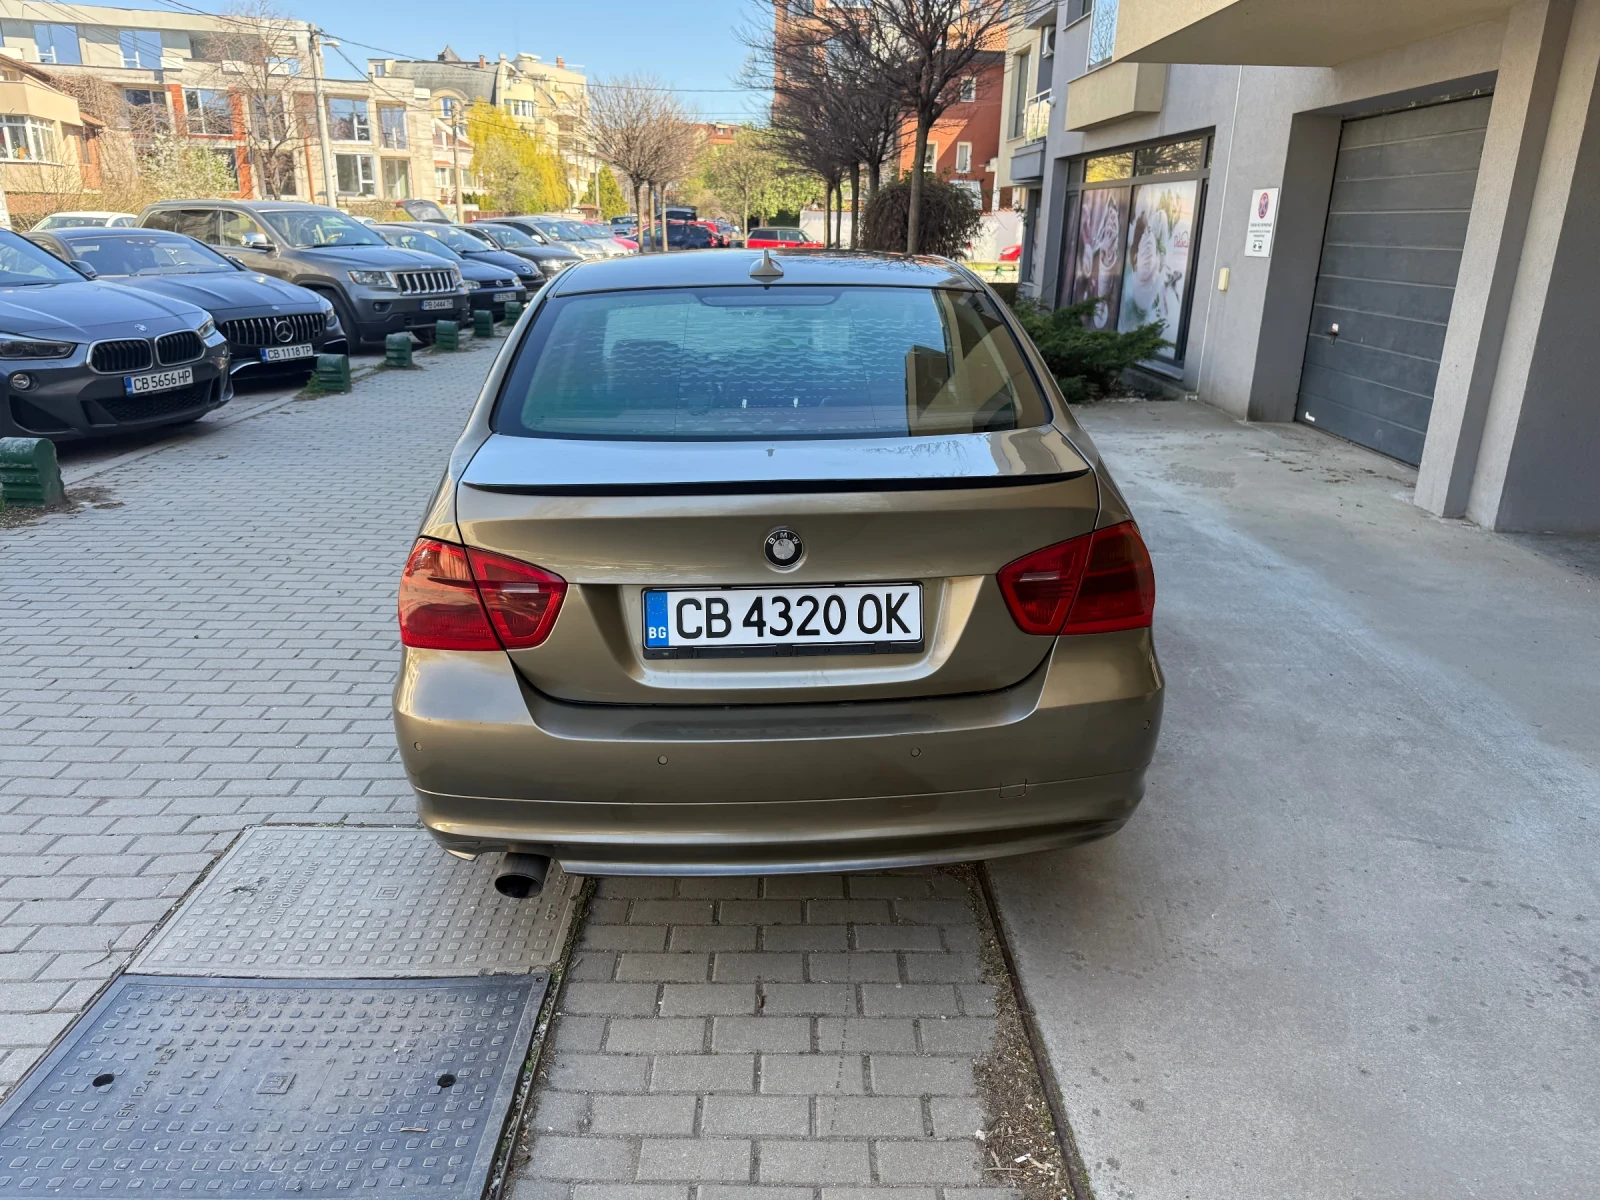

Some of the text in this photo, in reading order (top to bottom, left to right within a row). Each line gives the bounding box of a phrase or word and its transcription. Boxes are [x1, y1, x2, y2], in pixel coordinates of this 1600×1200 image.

[267, 345, 311, 360] CB 1118 TP
[133, 369, 191, 391] CB 5656 HP
[768, 532, 801, 545] BMW
[675, 592, 912, 640] CB 4320 OK
[648, 626, 667, 640] BG
[114, 1102, 136, 1118] EN
[129, 1080, 154, 1098] 124
[154, 1048, 177, 1066] 125
